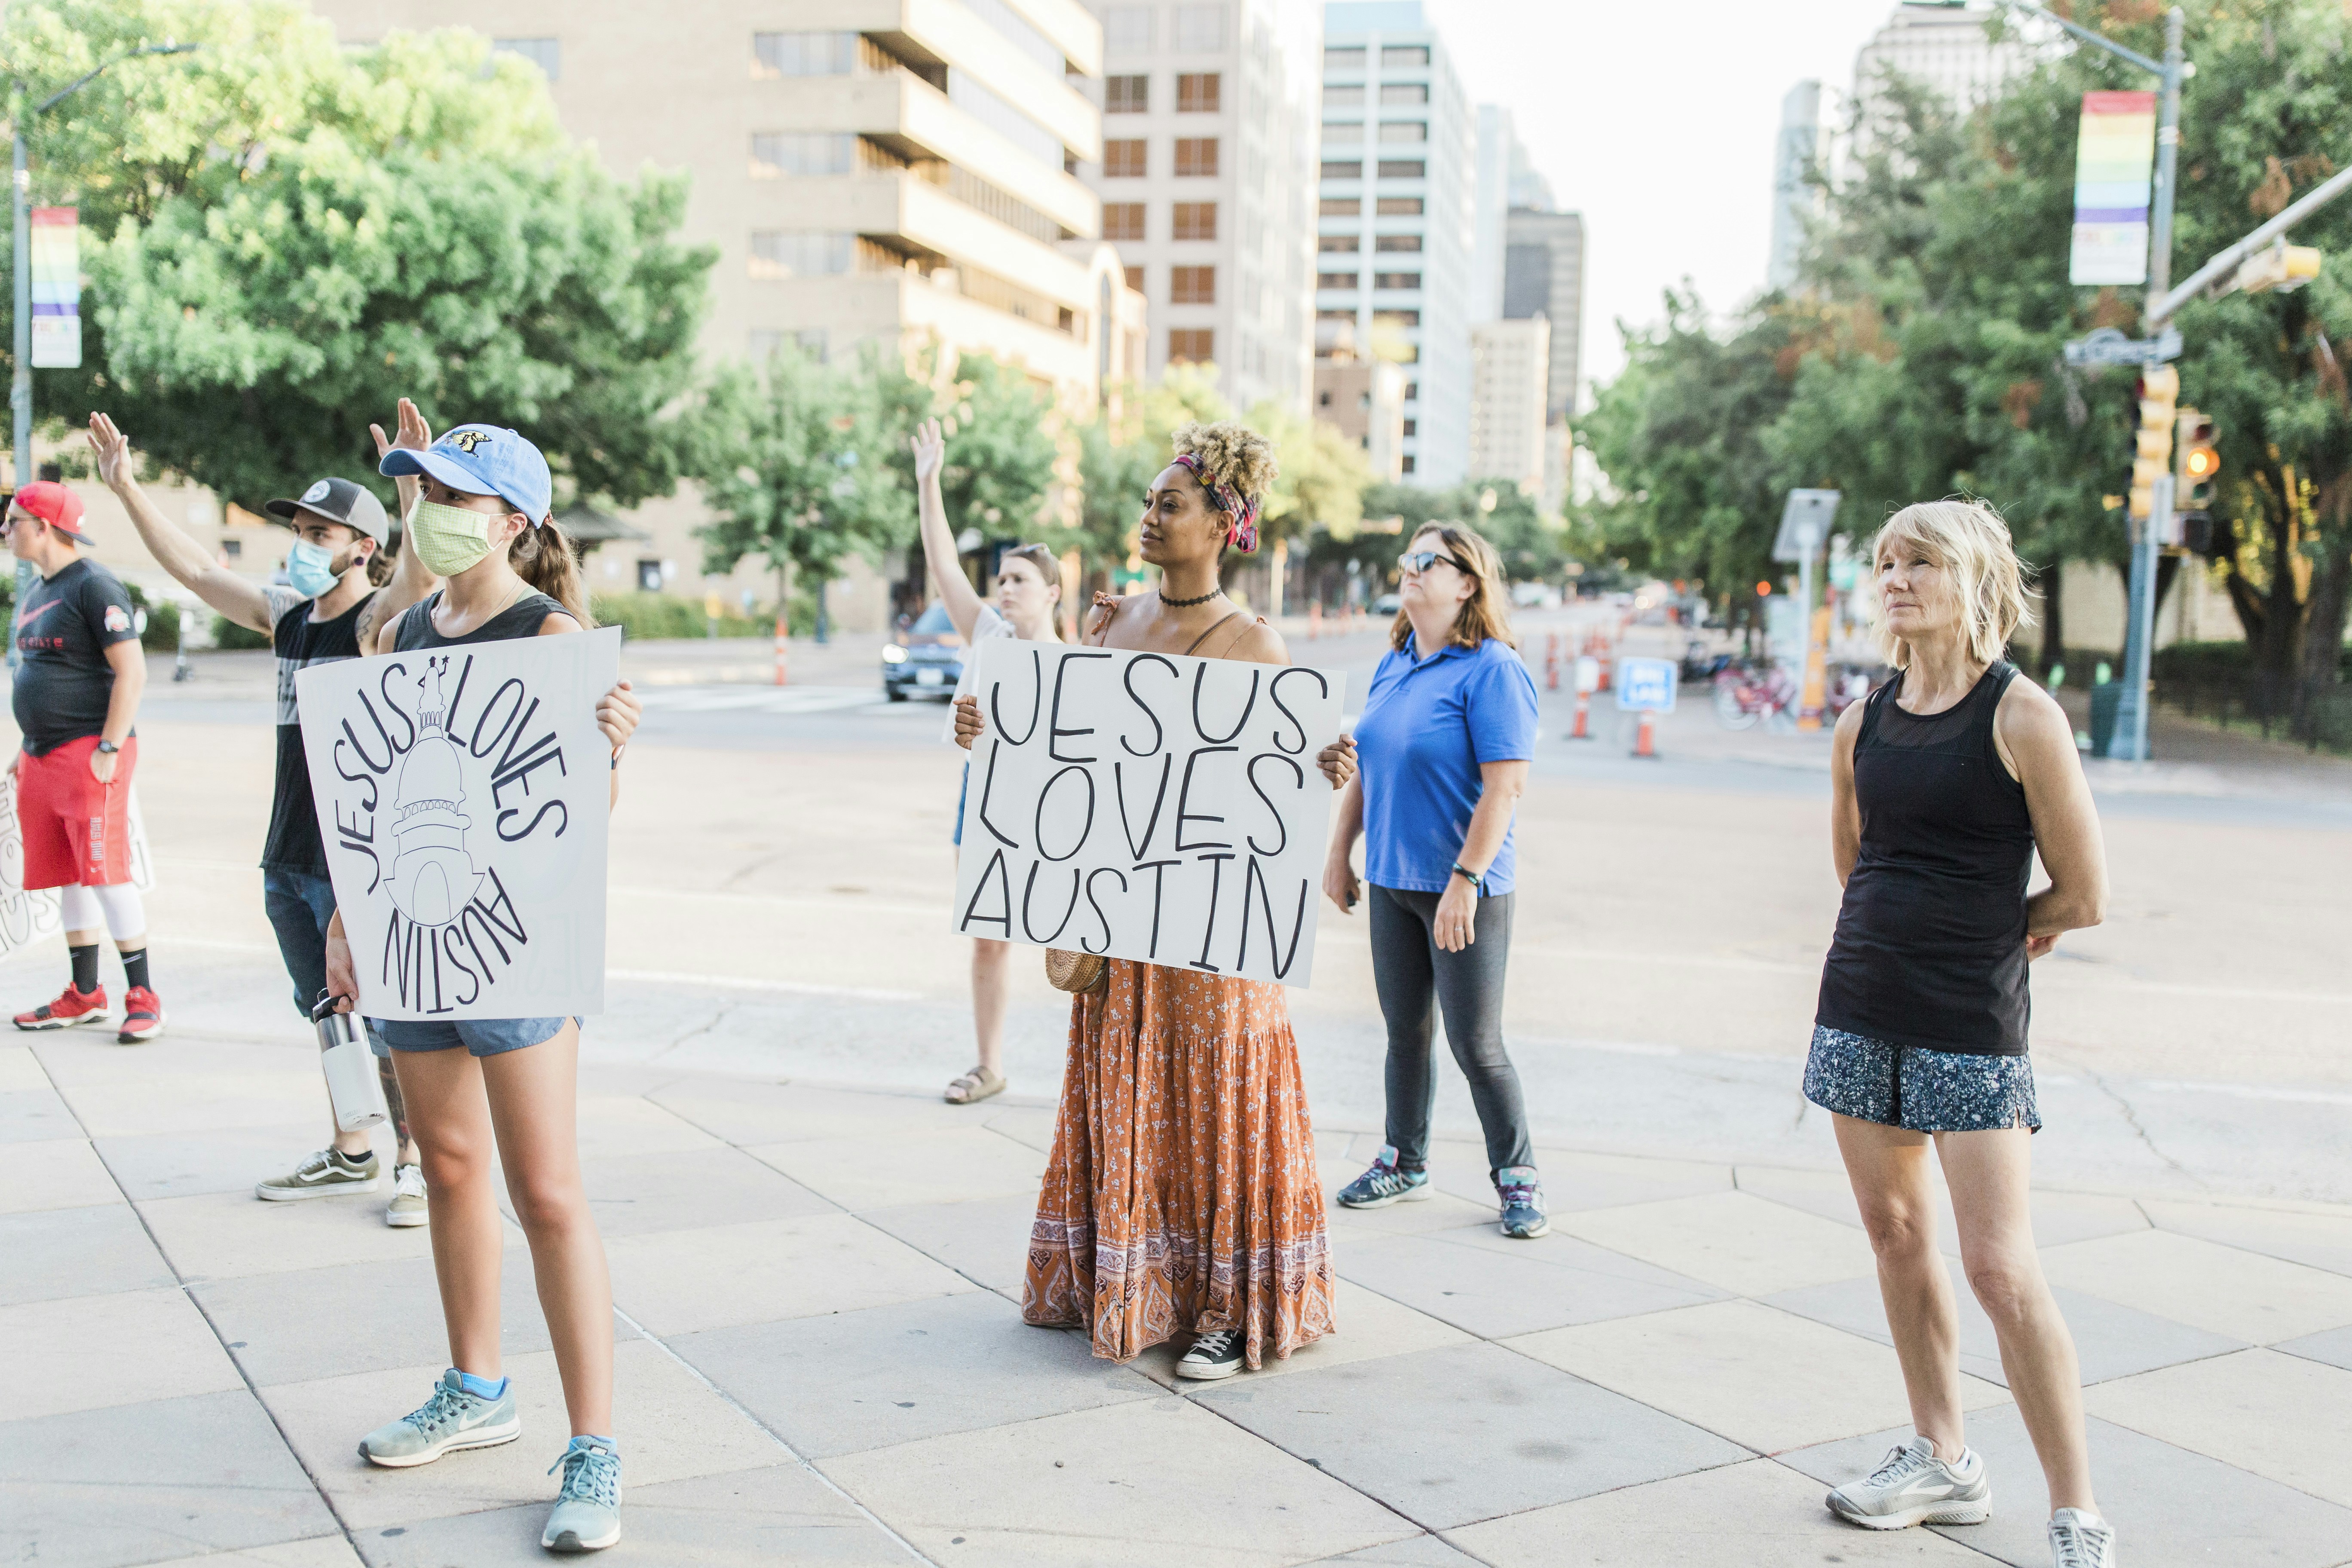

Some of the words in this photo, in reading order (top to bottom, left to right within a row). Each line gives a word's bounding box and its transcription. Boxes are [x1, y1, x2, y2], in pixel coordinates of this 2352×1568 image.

[991, 649, 1328, 762] JESUS
[334, 663, 416, 895] JESUS
[444, 654, 568, 842] LOVES
[980, 738, 1304, 861] LOVES
[383, 866, 528, 1014] AUSTIN
[961, 848, 1308, 979] AUSTIN
